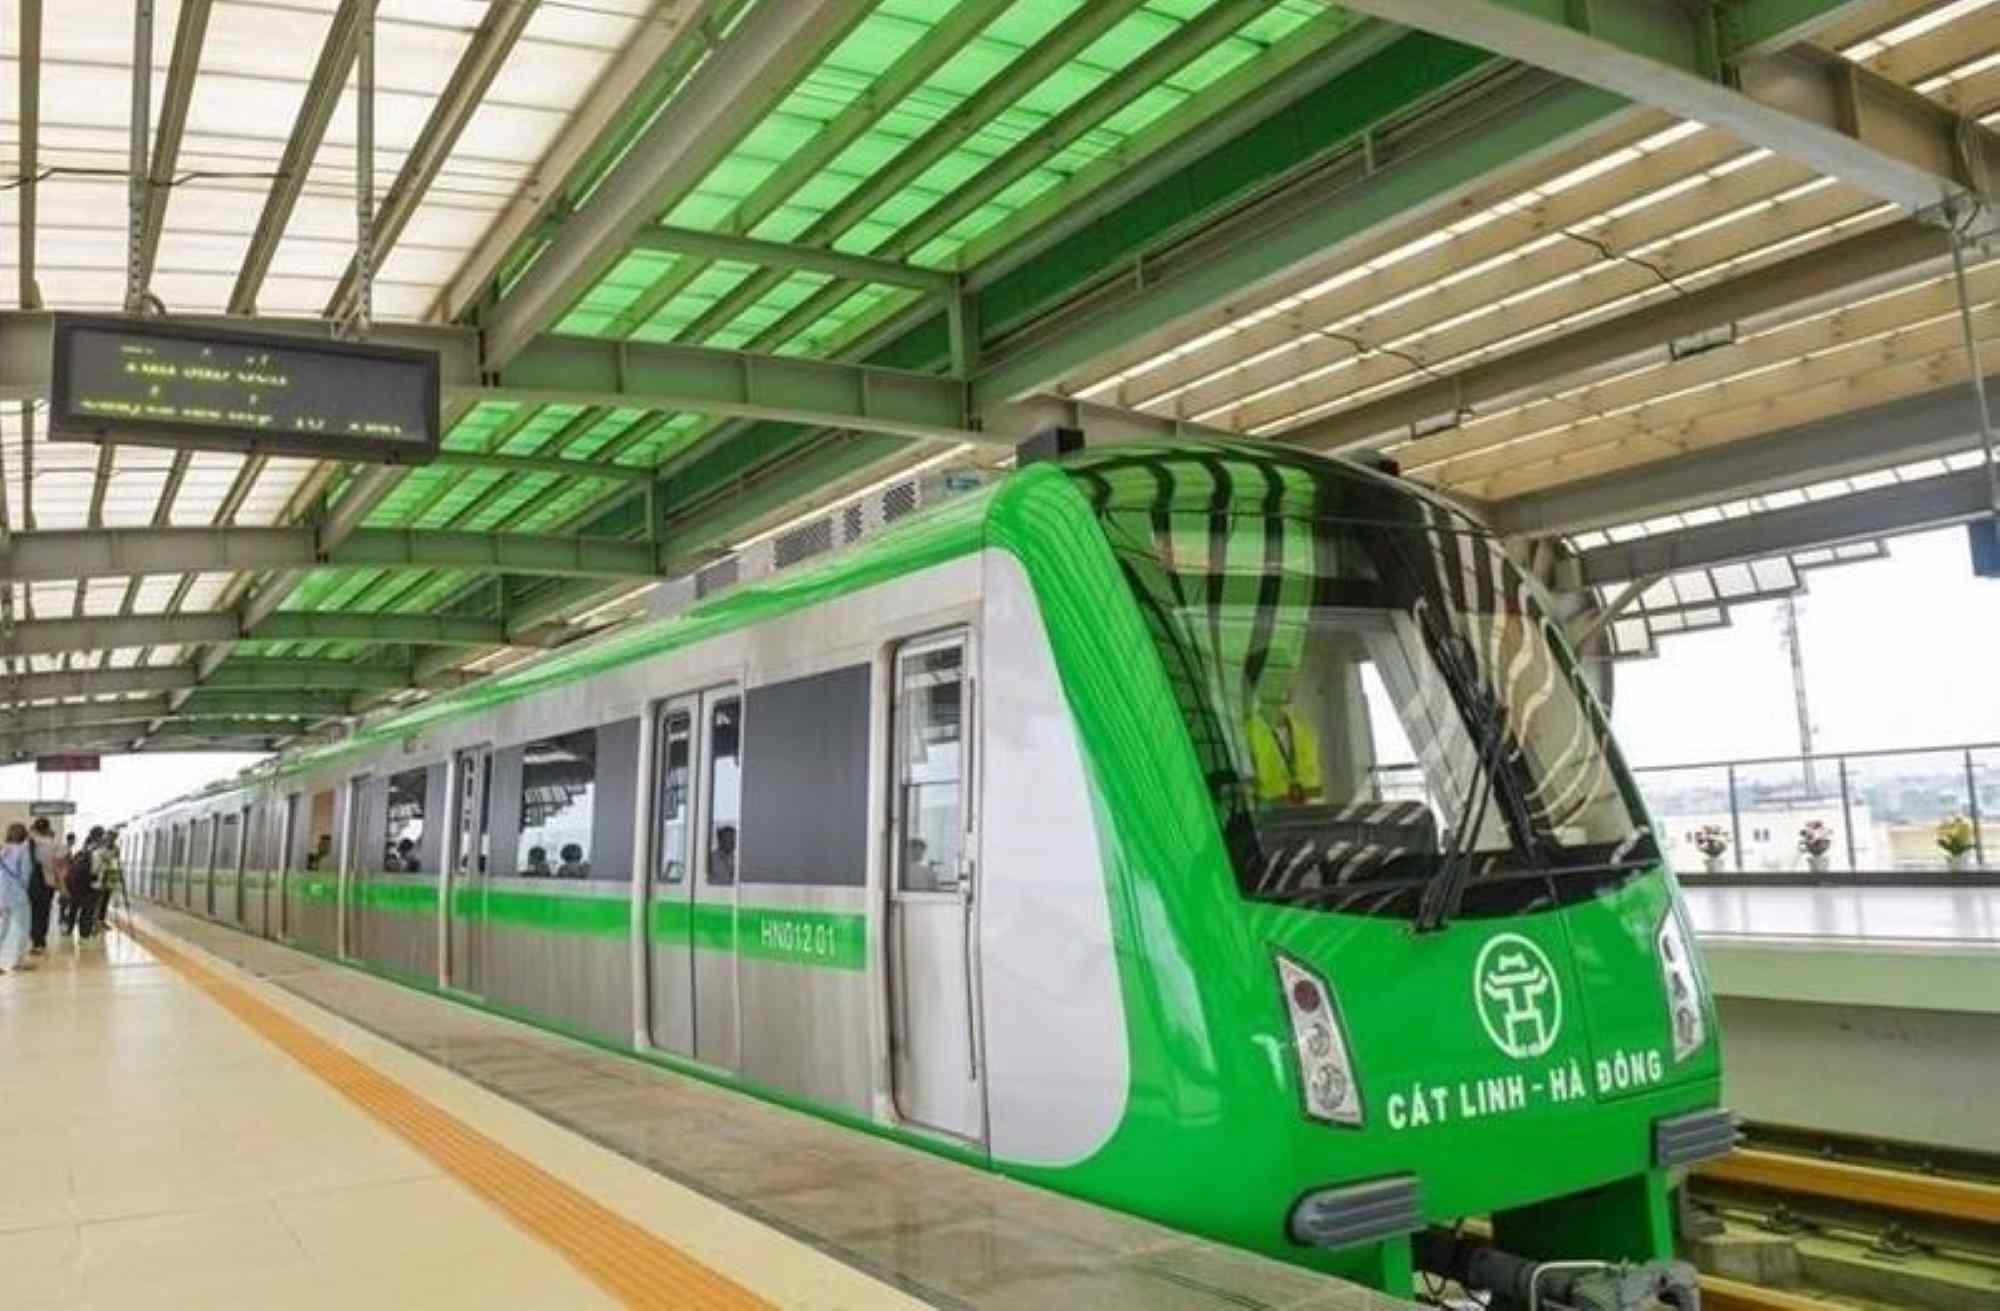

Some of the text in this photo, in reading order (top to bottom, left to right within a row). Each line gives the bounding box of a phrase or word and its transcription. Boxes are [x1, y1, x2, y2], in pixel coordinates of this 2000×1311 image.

[1387, 1082, 1449, 1129] CÁT
[1460, 1075, 1526, 1118] LINH
[1549, 1058, 1586, 1101] HÀ
[1596, 1049, 1662, 1093] ĐÔNG
